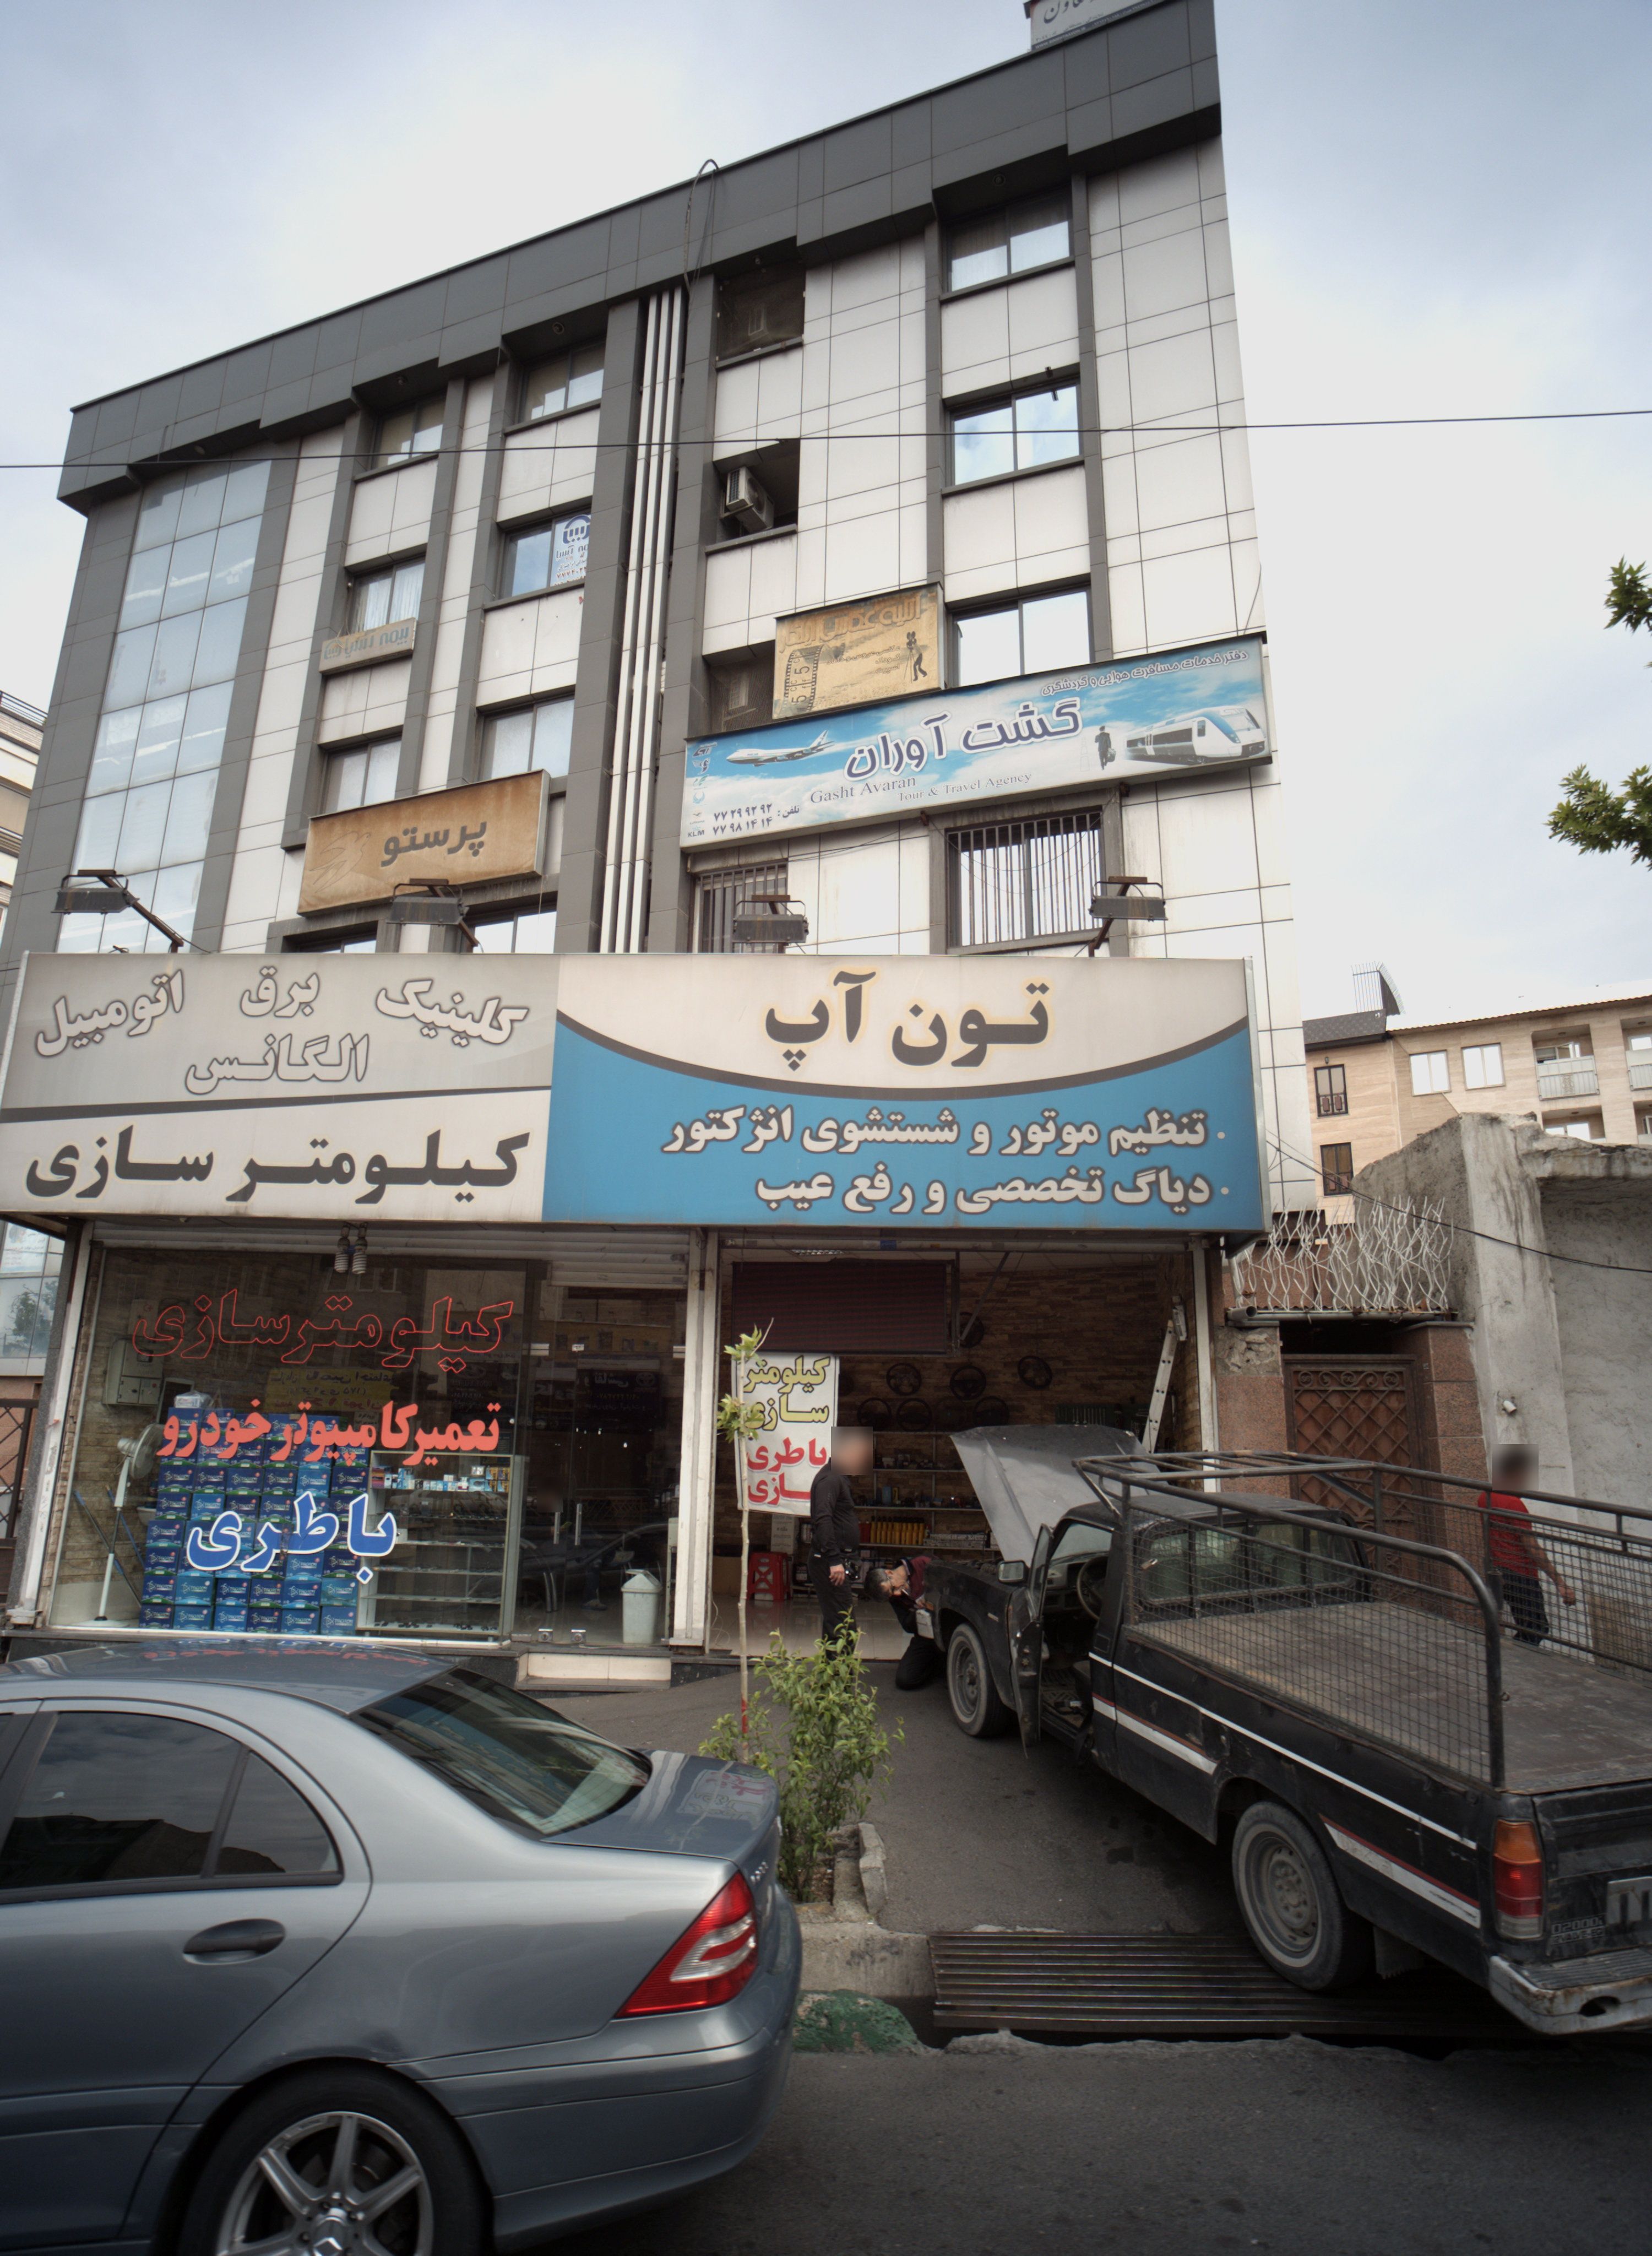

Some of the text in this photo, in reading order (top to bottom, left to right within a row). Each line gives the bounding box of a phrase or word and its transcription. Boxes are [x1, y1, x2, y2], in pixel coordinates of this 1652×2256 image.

[379, 627, 410, 646] بیمه
[1042, 650, 1249, 696] دفتر خدمات مسافرت هوایی و گردشگری
[846, 700, 1080, 779] گشت آوران
[810, 777, 916, 804] Gasht Avaran
[898, 773, 1032, 802] Tour & Travel Agency
[381, 821, 487, 867] پرستو
[688, 829, 704, 838] KLM
[35, 966, 529, 1058] کلینیک برق اتومبیل
[764, 971, 1050, 1071] تون آپ
[184, 1033, 369, 1094] الگانس
[660, 1104, 1208, 1157] تنظیم موتور و شستشوی انژکتور
[26, 1125, 530, 1204] کیلومتر سازی
[755, 1162, 1212, 1215] دیاگ تخصصی و رفع عیب
[133, 1288, 514, 1374] کیلومتر سازی
[743, 1354, 830, 1393] کیلومتر
[156, 1398, 502, 1466] تعمیر کامپیوتر خودرو
[745, 1392, 829, 1431] سازی
[747, 1436, 827, 1472] باطری
[748, 1472, 811, 1506] ازی
[186, 1491, 398, 1585] باطری
